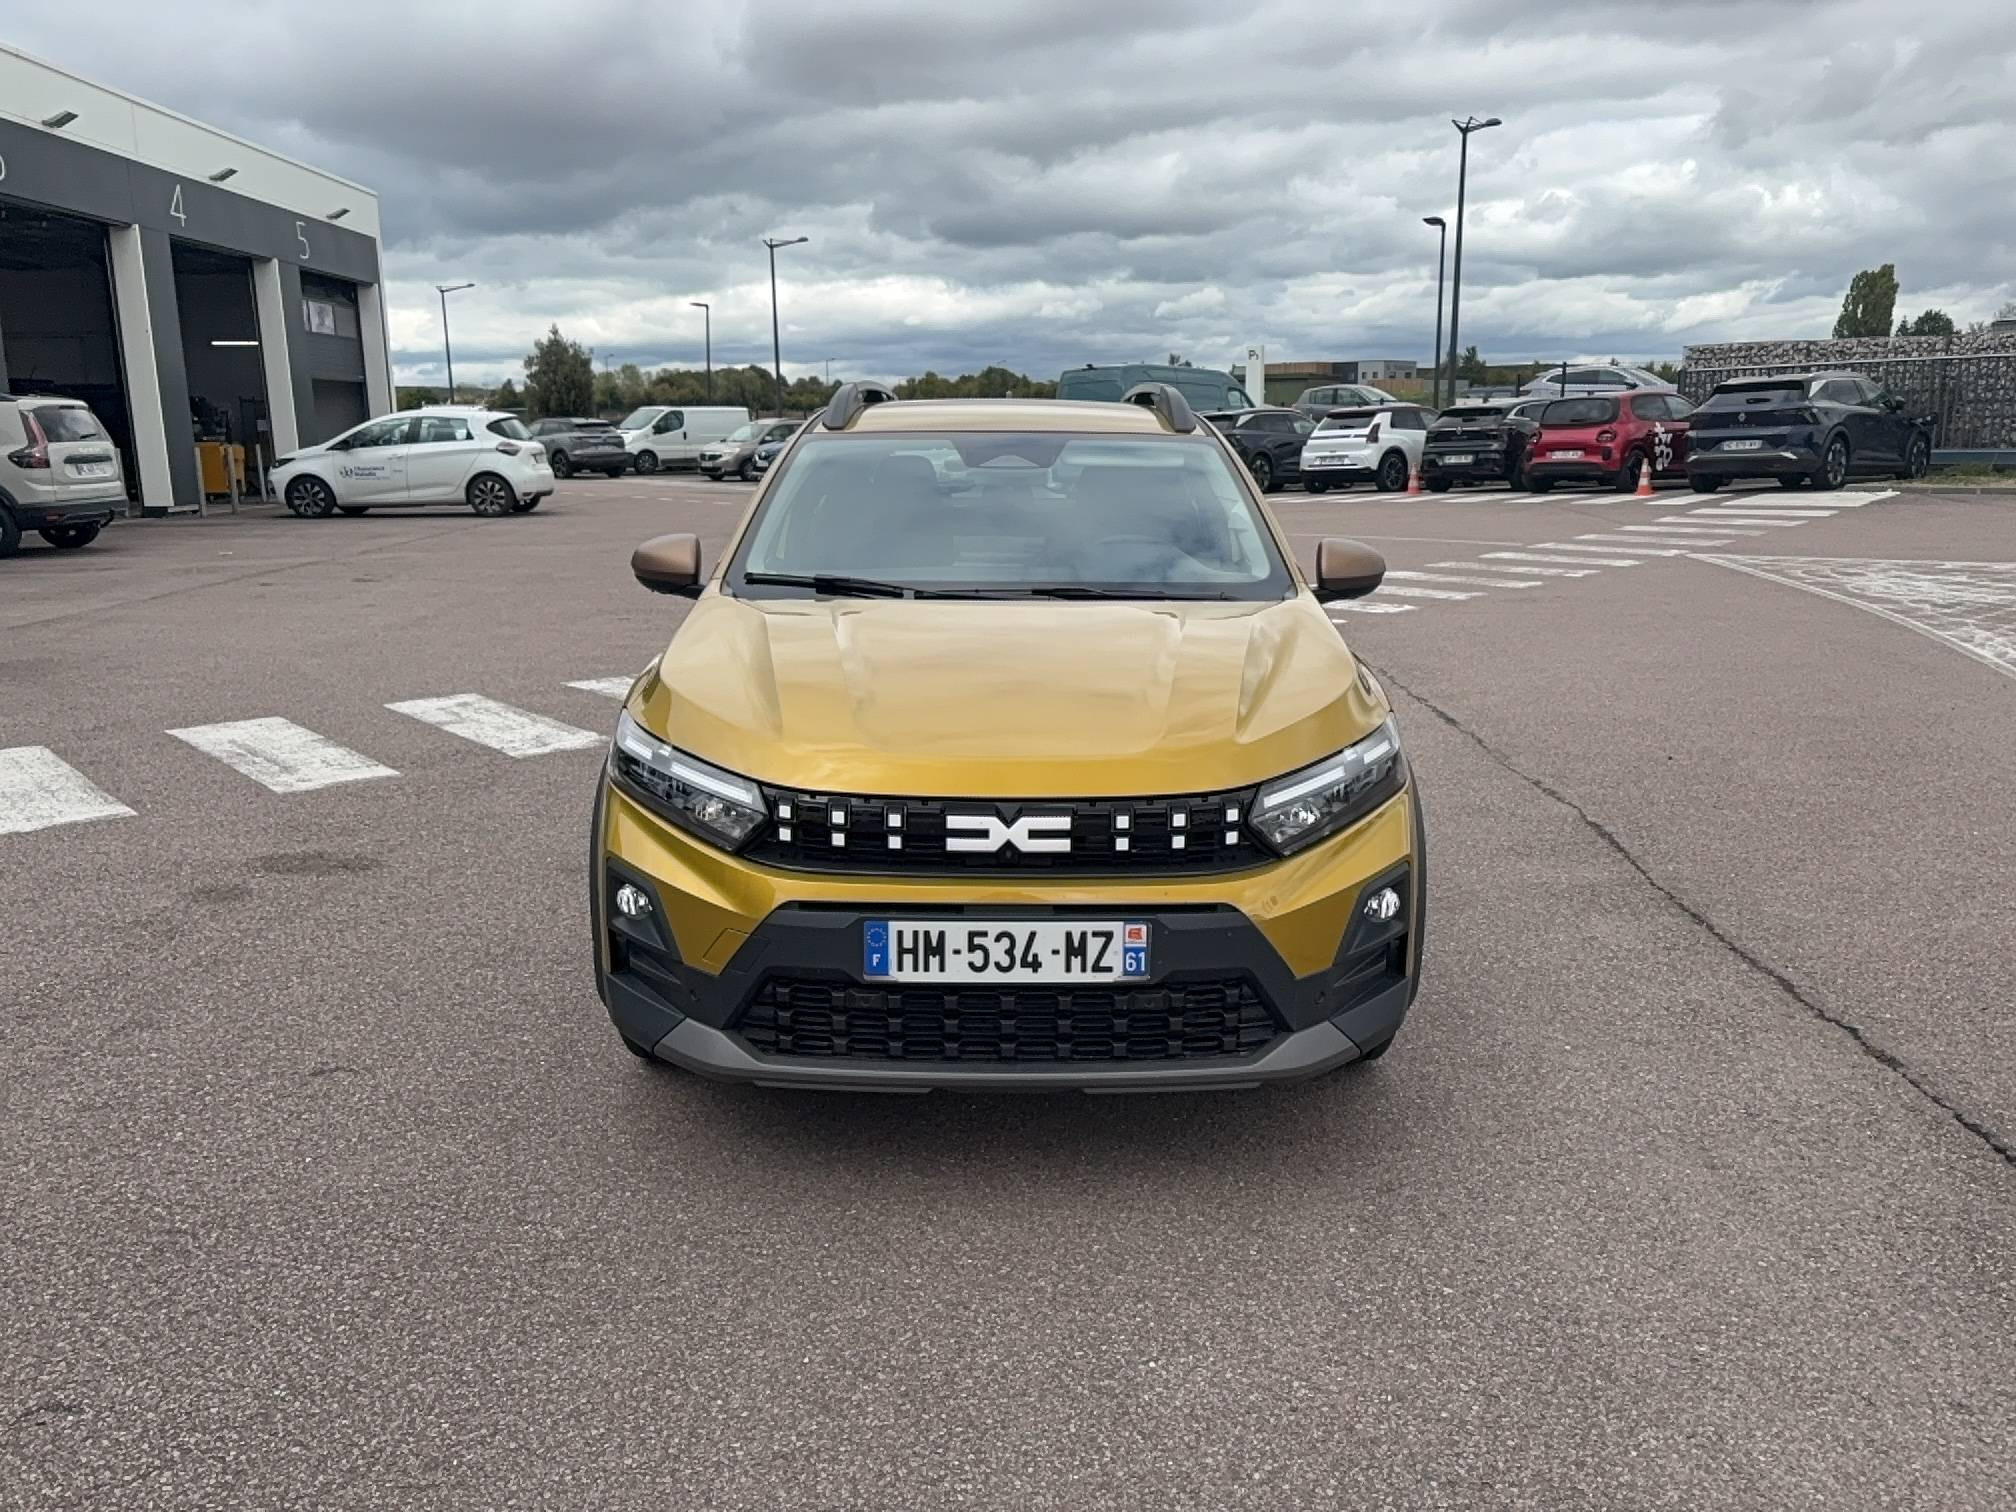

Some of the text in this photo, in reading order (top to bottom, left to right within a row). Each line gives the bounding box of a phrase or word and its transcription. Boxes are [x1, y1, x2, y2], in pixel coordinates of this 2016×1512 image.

[170, 184, 187, 227] 4
[295, 221, 310, 259] 5
[872, 954, 881, 967] F
[896, 929, 1115, 974] HM-534-MZ
[1125, 950, 1146, 972] 61
